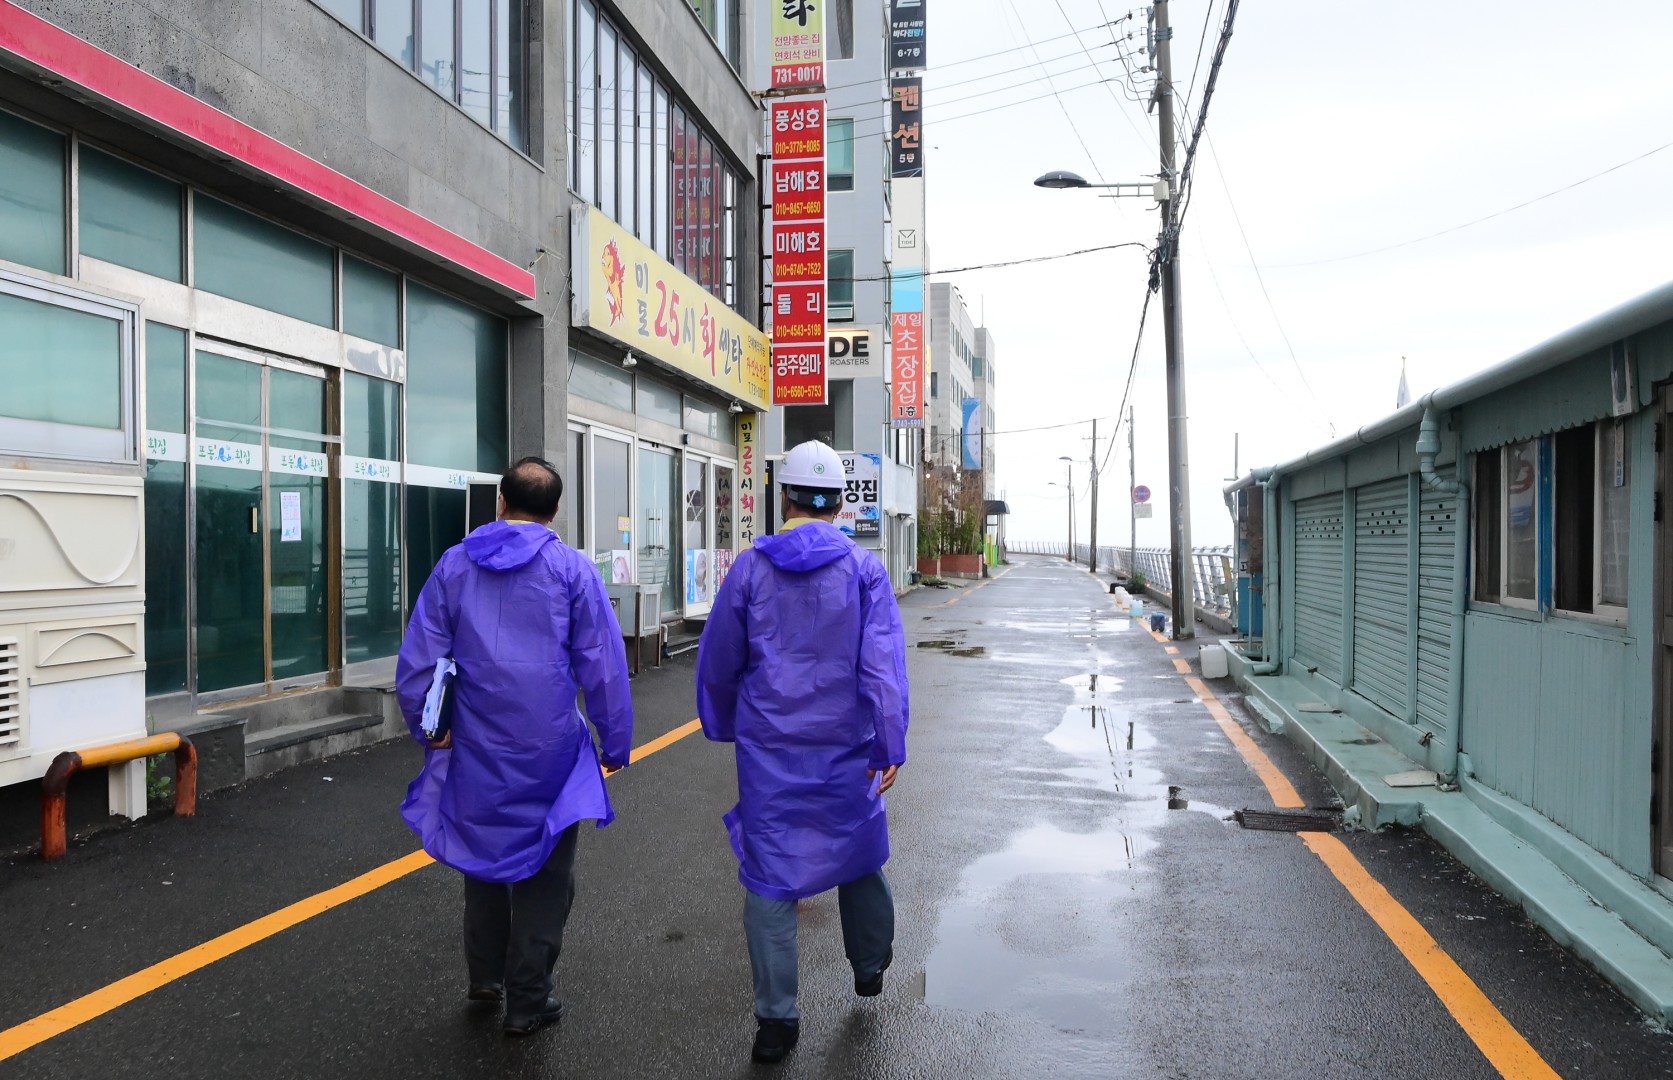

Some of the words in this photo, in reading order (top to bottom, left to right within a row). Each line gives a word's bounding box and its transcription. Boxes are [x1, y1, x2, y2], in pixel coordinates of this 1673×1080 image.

[775, 34, 809, 46] 전망좋은
[812, 33, 820, 43] 집
[775, 49, 800, 61] 연회석
[775, 66, 821, 83] 731-0017
[775, 108, 820, 132] 풍성호
[892, 85, 919, 148] 펜션
[775, 170, 820, 192] 남해호
[776, 231, 820, 253] 미해호
[893, 313, 922, 327] 제일
[829, 336, 869, 357] DE
[777, 353, 821, 377] 공주엄마
[830, 358, 869, 366] ROASTERS
[896, 329, 919, 404] 초장집
[899, 406, 916, 416] 1층
[842, 459, 855, 474] 일
[843, 480, 877, 503] 장집
